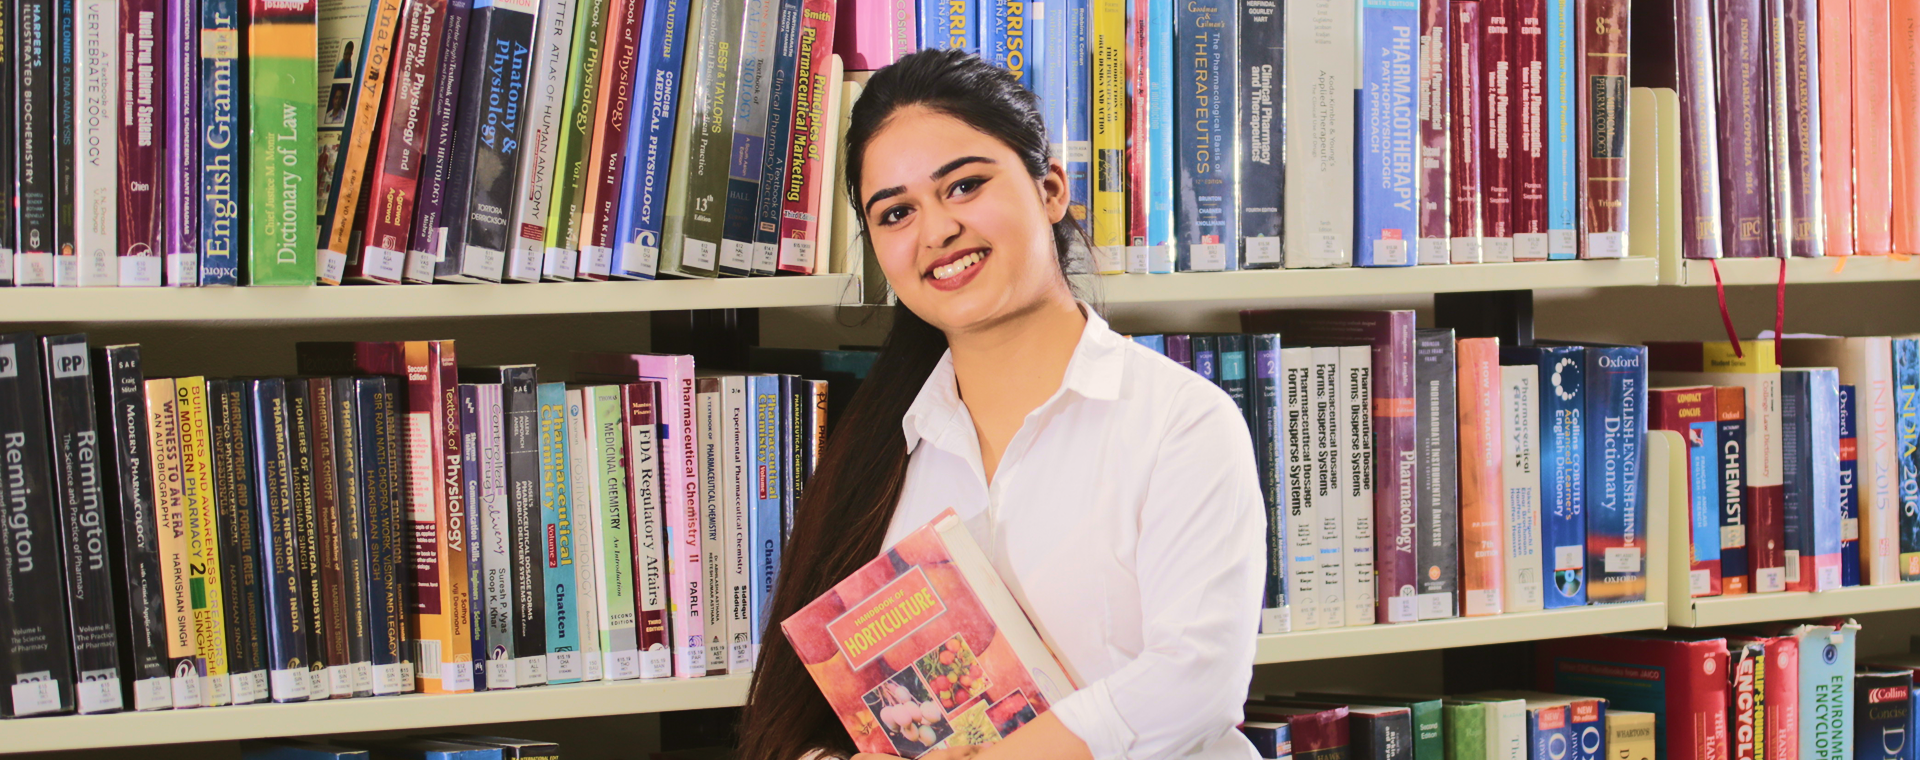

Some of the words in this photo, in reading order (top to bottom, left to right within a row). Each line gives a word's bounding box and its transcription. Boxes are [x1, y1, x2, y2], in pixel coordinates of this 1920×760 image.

[63, 17, 71, 63] CLONING
[408, 1, 422, 39] Health
[414, 4, 435, 68] Anatomy,
[804, 9, 831, 21] Smith
[1798, 20, 1807, 62] INDIAN
[24, 4, 32, 85] ILLUSTRATED
[88, 3, 99, 92] VERTEBRATE
[548, 43, 559, 81] ATLAS
[717, 41, 728, 71] BEST
[63, 77, 71, 96] DNA
[138, 65, 154, 104] Delivery
[400, 43, 417, 100] Education
[482, 39, 510, 149] Physiology
[502, 41, 527, 133] Anatomy
[576, 46, 598, 135] Physiology
[611, 44, 634, 132] Physiology
[661, 71, 673, 118] CONCISE
[772, 69, 785, 111] Clinical
[795, 27, 816, 132] Pharmaceutical
[1212, 54, 1222, 133] Pharmacological
[1251, 66, 1261, 87] and
[1261, 64, 1272, 104] Clinical
[1319, 70, 1327, 106] Applied
[1497, 61, 1508, 93] Modern
[1530, 61, 1542, 93] Modern
[63, 100, 71, 145] ANALYSIS
[138, 106, 153, 146] Systems
[277, 103, 297, 141] Law
[403, 73, 426, 145] Physiology
[439, 108, 451, 144] HUMAN
[650, 69, 665, 132] MEDICAL
[711, 81, 726, 133] TAYLOR'S
[809, 74, 826, 141] Principles
[1195, 32, 1210, 174] THERAPEUTICS
[1250, 90, 1261, 162] Therapeutics
[1371, 82, 1380, 153] APPROACH
[1382, 60, 1391, 189] PATHOPHYSIOLOGIC
[1392, 26, 1411, 211] PHARMACOTHERAPY
[1432, 73, 1443, 130] Pharmaceutical
[1497, 96, 1508, 158] Pharmaceutics
[1530, 96, 1541, 157] Pharmaceutics
[1595, 78, 1606, 157] PHARMACOLOGY
[1740, 18, 1749, 59] INDIAN
[1745, 171, 1753, 195] 2014
[24, 91, 33, 184] BIOCHEMISTRY
[88, 97, 99, 166] ZOOLOGY
[540, 105, 552, 153] HUMAN
[765, 113, 779, 171] Pharmacy
[1214, 135, 1222, 160] Basis
[1258, 107, 1272, 164] Pharmacy
[1319, 110, 1328, 172] Therapeutics
[401, 148, 412, 170] and
[431, 147, 446, 206] HISTOLOGY
[641, 135, 658, 225] PHYSIOLOGY
[772, 166, 782, 204] Textbook
[787, 134, 807, 202] Marketing
[131, 181, 149, 191] Chien
[206, 155, 238, 259] English
[266, 178, 274, 207] Justice
[385, 188, 396, 224] Agrawal
[394, 190, 406, 227] Agrawal
[477, 203, 503, 215] TORTORA
[531, 157, 546, 220] ANATOMY
[762, 173, 773, 218] Practice
[266, 215, 274, 235] Chief
[277, 172, 302, 265] Dictionary
[471, 212, 507, 226] DERRICKSON
[1598, 355, 1639, 368] Oxford
[162, 400, 177, 461] WITNESS
[445, 387, 457, 437] Textbook
[682, 379, 695, 478] Pharmaceutical
[756, 394, 768, 464] Chemistry
[1299, 367, 1312, 462] Pharmaceutical
[1316, 401, 1328, 448] Disperse
[1327, 363, 1337, 448] Pharmaceutical
[1350, 405, 1361, 449] Disperse
[1361, 367, 1371, 449] Pharmaceutical
[1522, 378, 1531, 473] Pharmaceutical
[1553, 410, 1564, 452] English
[1571, 408, 1580, 450] Collins
[1840, 390, 1848, 435] Oxford
[1873, 379, 1887, 453] INDIA
[1901, 384, 1918, 458] INDIA
[180, 410, 195, 473] MODERN
[540, 404, 556, 512] Chemistry
[604, 422, 616, 474] MEDICINAL
[639, 430, 651, 463] FDA
[733, 407, 742, 463] Experimental
[767, 394, 778, 500] Pharmaceutical
[1288, 410, 1301, 463] Disperse
[1564, 409, 1572, 465] Advanced
[155, 431, 170, 529] AUTOBIOGRAPHY
[553, 404, 572, 566] Pharmaceutical
[707, 444, 717, 502] PHARMACEUTICAL
[1302, 464, 1313, 508] Dosage
[1318, 450, 1329, 496] Systems
[1329, 449, 1339, 489] Dosage
[1351, 451, 1363, 497] Systems
[1362, 451, 1371, 490] Dosage
[1430, 448, 1441, 506] INSTRUMENTAL
[1554, 456, 1566, 517] Dictionary
[1572, 453, 1581, 515] COBUILD
[1601, 416, 1621, 511] Dictionary
[1875, 461, 1890, 510] 2015
[4, 431, 34, 572] Remington
[76, 430, 105, 570] Remington
[129, 458, 145, 549] PHARMACOLOGY
[272, 398, 290, 506] PHARMACEUTICAL
[281, 509, 296, 574] HISTORY
[290, 597, 300, 633] INDIA
[446, 454, 464, 552] Physiology
[608, 477, 621, 529] CHEMISTRY
[640, 468, 658, 552] Regulatory
[685, 481, 698, 546] Chemistry
[734, 465, 743, 530] Pharmaceutical
[1289, 464, 1302, 517] Systems
[1396, 450, 1415, 553] Pharmacology
[1565, 468, 1573, 520] Learner's
[1903, 466, 1918, 517] 2016
[171, 512, 184, 539] ERA
[185, 477, 202, 559] PHARMACY
[200, 496, 217, 585] AWARENESS
[301, 475, 317, 576] PHARMACEUTICAL
[708, 504, 717, 541] CHEMISTRY
[1431, 508, 1442, 547] ANALYSIS
[488, 568, 497, 593] Roop
[646, 554, 661, 606] Affairs
[735, 533, 744, 575] Chemistry
[1604, 575, 1637, 584] OXFORD
[172, 553, 186, 613] HARKISHAN
[308, 579, 322, 635] INDUSTRY
[498, 568, 506, 599] Suresh
[689, 581, 699, 617] PARLE
[854, 597, 895, 627] HANDBOOK
[894, 589, 905, 600] OF
[176, 615, 188, 648] SINGH
[490, 606, 499, 628] Khar
[498, 611, 508, 634] Vyas
[556, 583, 566, 638] Chatten
[843, 587, 937, 658] HORTICULTURE
[1543, 712, 1560, 721] NEW
[1577, 706, 1593, 714] NEW
[1869, 707, 1908, 721] Concise
[1878, 688, 1907, 700] Collins
[1419, 722, 1438, 731] Second
[1420, 732, 1438, 740] Edition
[1616, 728, 1650, 738] WHARTON'S
